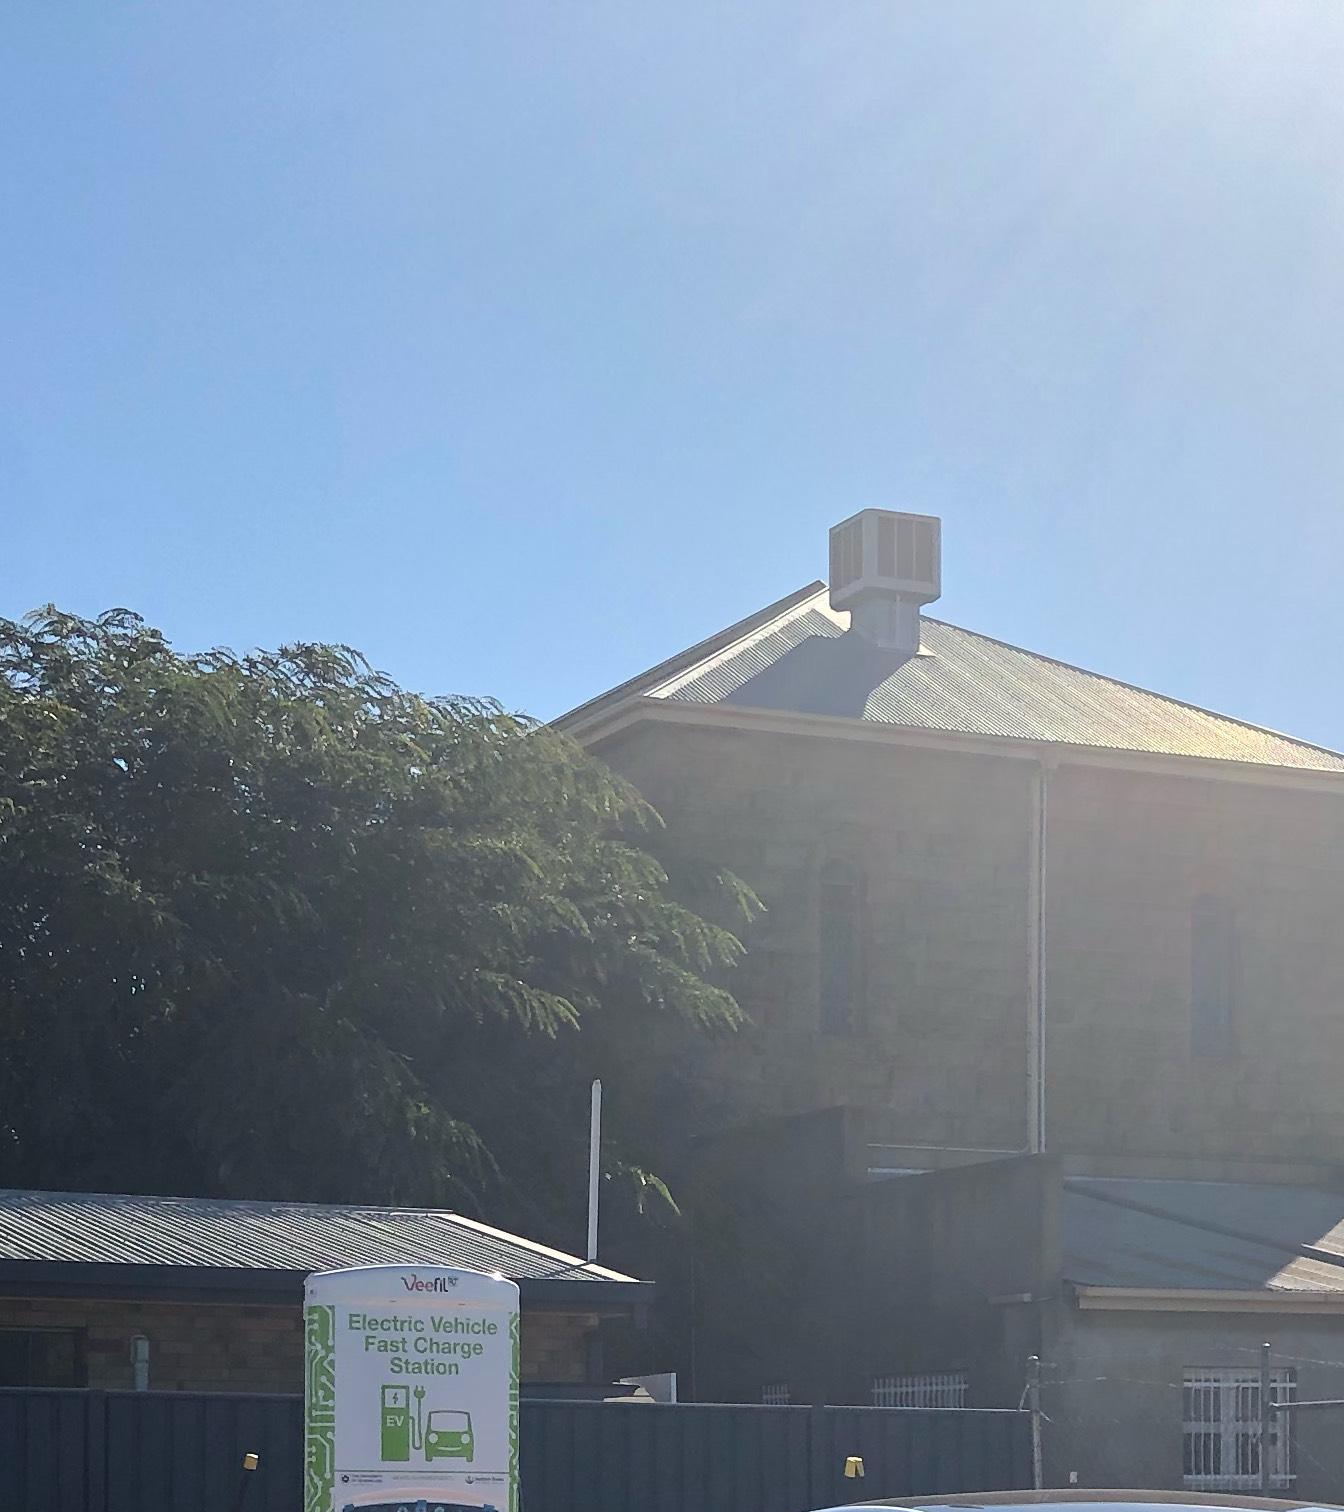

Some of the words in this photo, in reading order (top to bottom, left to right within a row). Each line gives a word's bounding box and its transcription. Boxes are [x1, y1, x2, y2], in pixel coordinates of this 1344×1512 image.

[401, 1274, 448, 1292] Veefil
[348, 1314, 424, 1332] Electric
[430, 1316, 497, 1335] Vehicle
[364, 1335, 408, 1354] Fast
[413, 1336, 484, 1360] Charge
[389, 1356, 460, 1376] Station
[386, 1415, 405, 1427] EV
